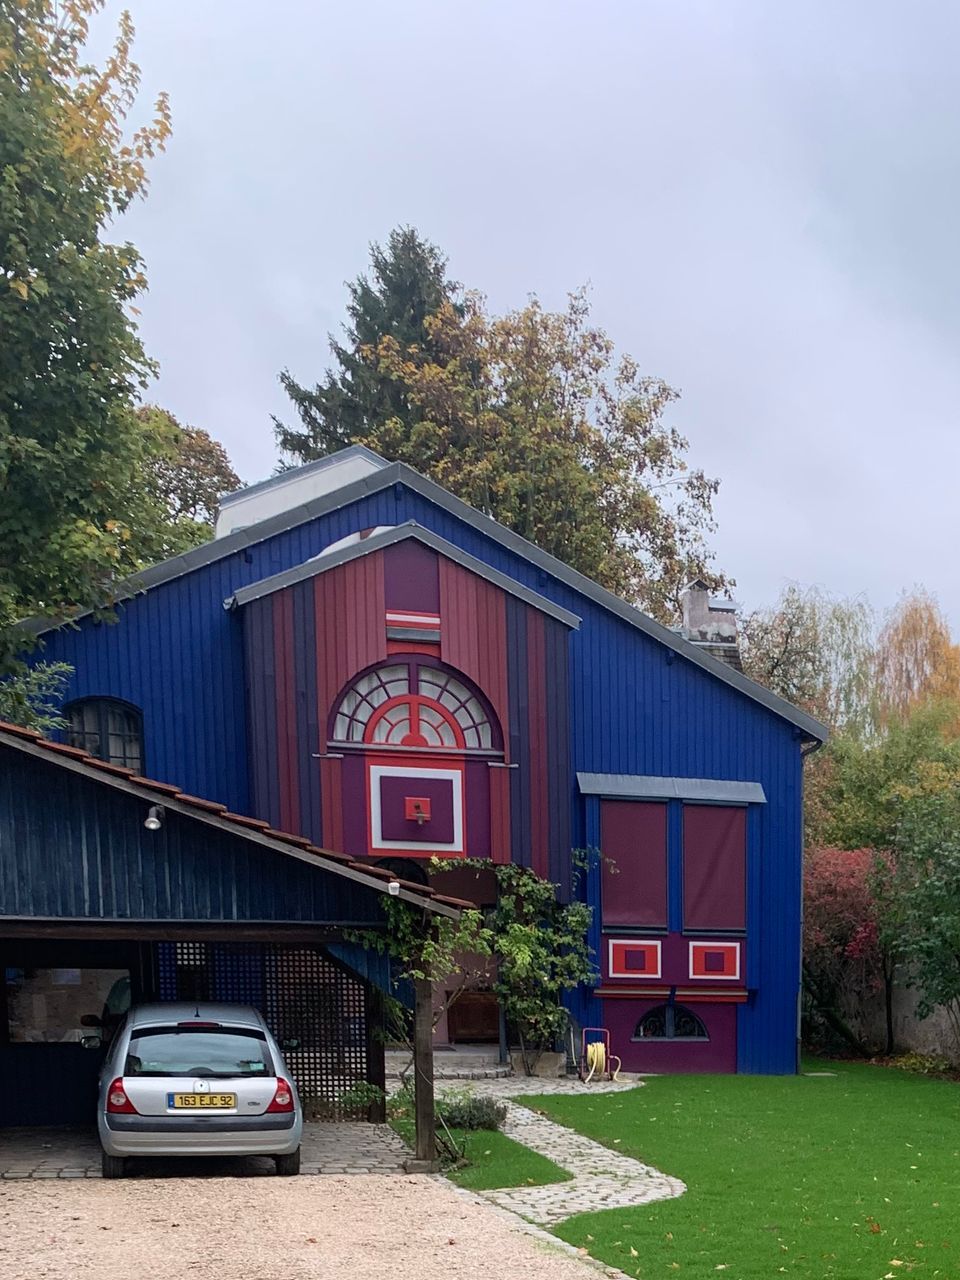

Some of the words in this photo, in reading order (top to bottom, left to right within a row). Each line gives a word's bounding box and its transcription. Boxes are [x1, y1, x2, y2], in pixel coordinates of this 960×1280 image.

[179, 1096, 196, 1106] 163
[200, 1096, 218, 1106] EJC
[220, 1096, 232, 1106] 92
